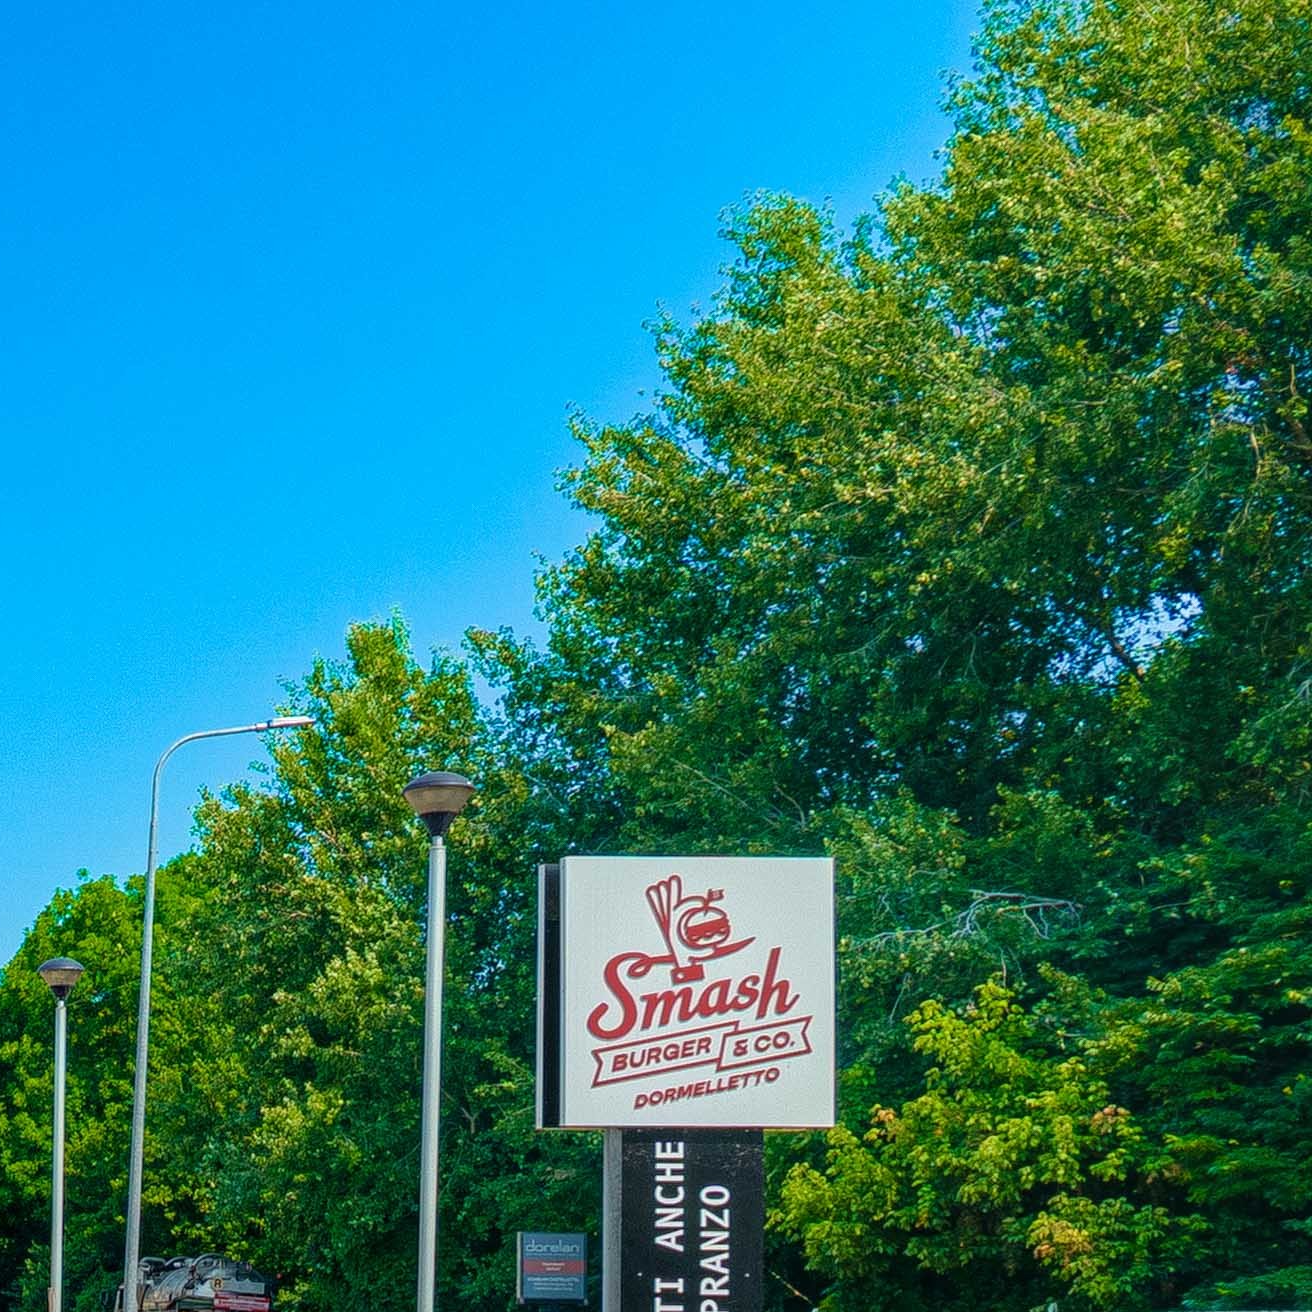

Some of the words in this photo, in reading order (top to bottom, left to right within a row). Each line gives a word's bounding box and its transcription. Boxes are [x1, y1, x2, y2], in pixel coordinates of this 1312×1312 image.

[586, 947, 800, 1041] Smash
[612, 1036, 712, 1073] BURGER
[733, 1039, 748, 1057] &
[753, 1031, 795, 1052] CO.
[634, 1067, 780, 1110] DORMELLETTO
[654, 1141, 685, 1252] ANCHE
[526, 1239, 580, 1252] dorelan
